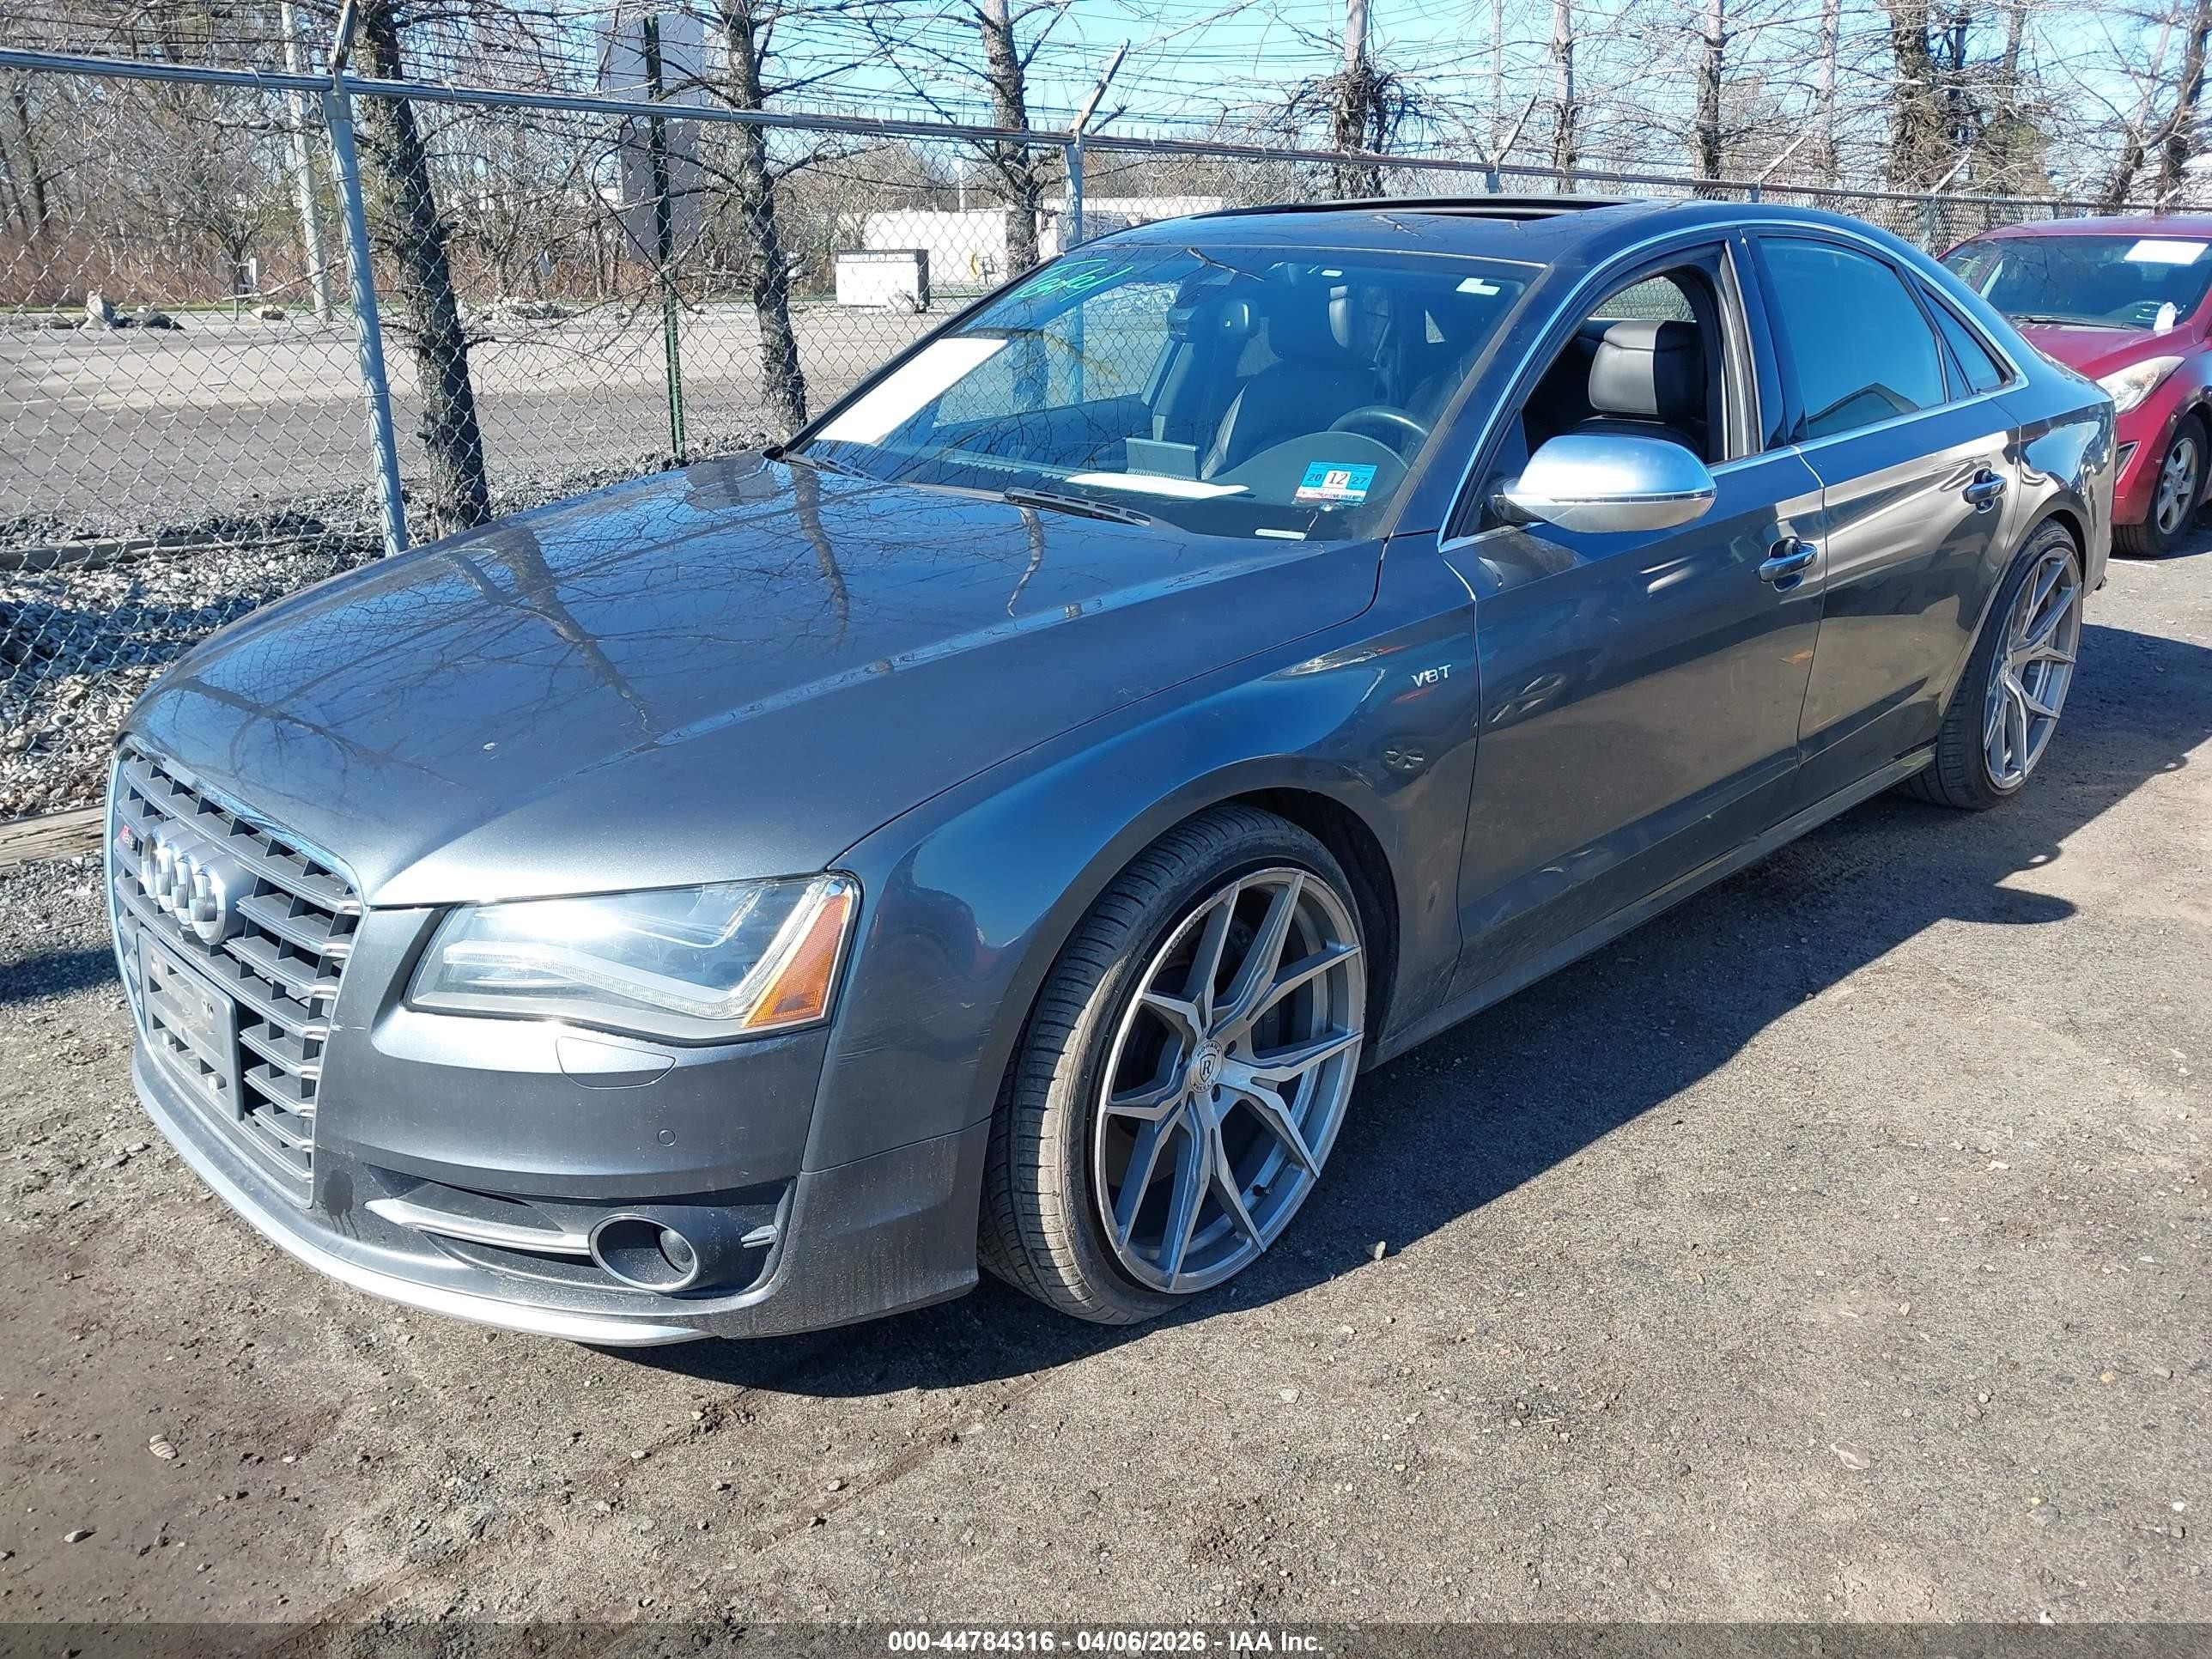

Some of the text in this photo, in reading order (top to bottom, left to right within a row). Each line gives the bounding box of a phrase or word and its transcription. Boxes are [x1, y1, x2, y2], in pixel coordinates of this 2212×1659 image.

[1307, 472, 1368, 485] 20 12 27
[1202, 1060, 1211, 1076] R
